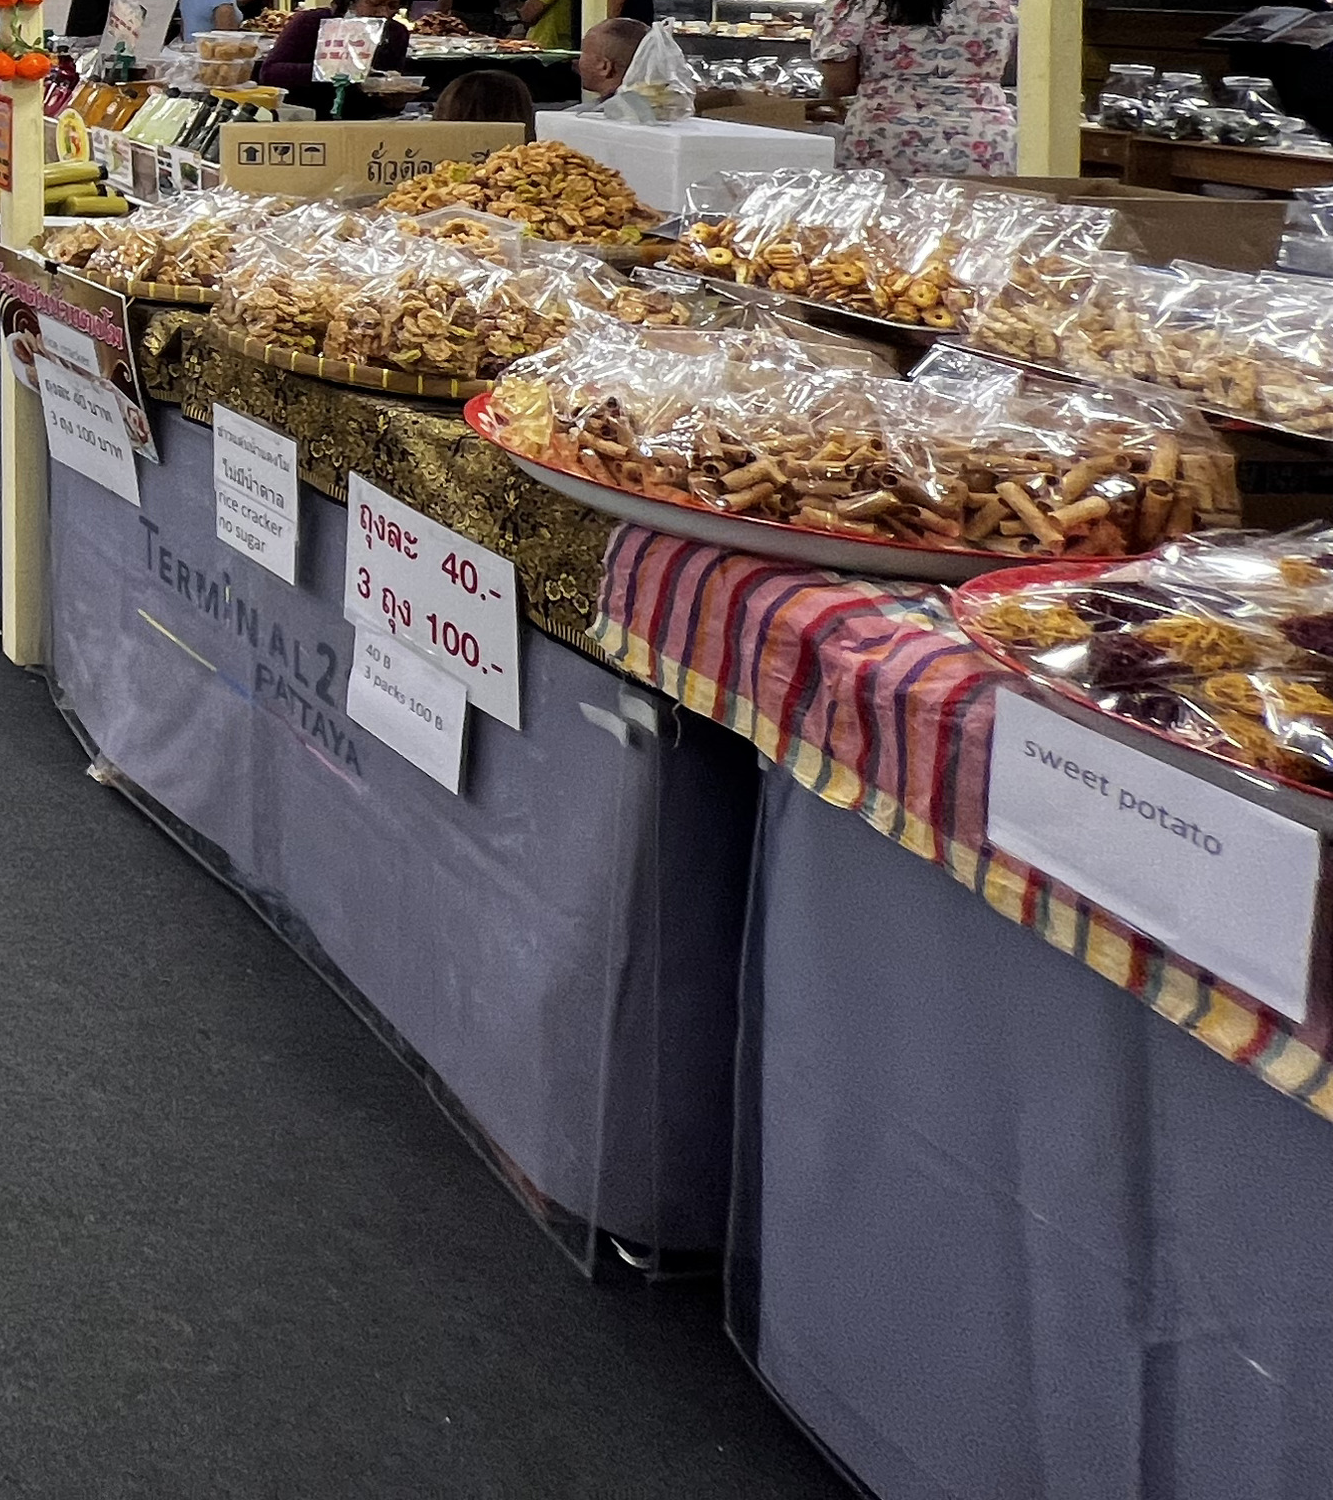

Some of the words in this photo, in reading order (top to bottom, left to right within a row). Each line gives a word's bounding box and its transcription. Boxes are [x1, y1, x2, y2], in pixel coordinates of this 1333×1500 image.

[50, 410, 57, 426] 3
[76, 424, 96, 446] 100
[98, 436, 124, 461] บาท
[87, 400, 113, 423] บาท
[218, 515, 233, 533] no
[235, 525, 266, 553] sugar
[241, 503, 284, 538] cracker
[359, 503, 419, 560] ถุงละ
[357, 567, 371, 599] 3
[382, 587, 412, 634] ถุง
[365, 643, 381, 663] 40
[383, 654, 392, 670] B
[255, 663, 362, 777] PATTAYA
[364, 665, 371, 679] 3
[374, 675, 406, 705] packs
[409, 697, 432, 723] 100
[435, 714, 443, 731] B
[1023, 737, 1109, 798] sweet
[1119, 787, 1224, 857] potato
